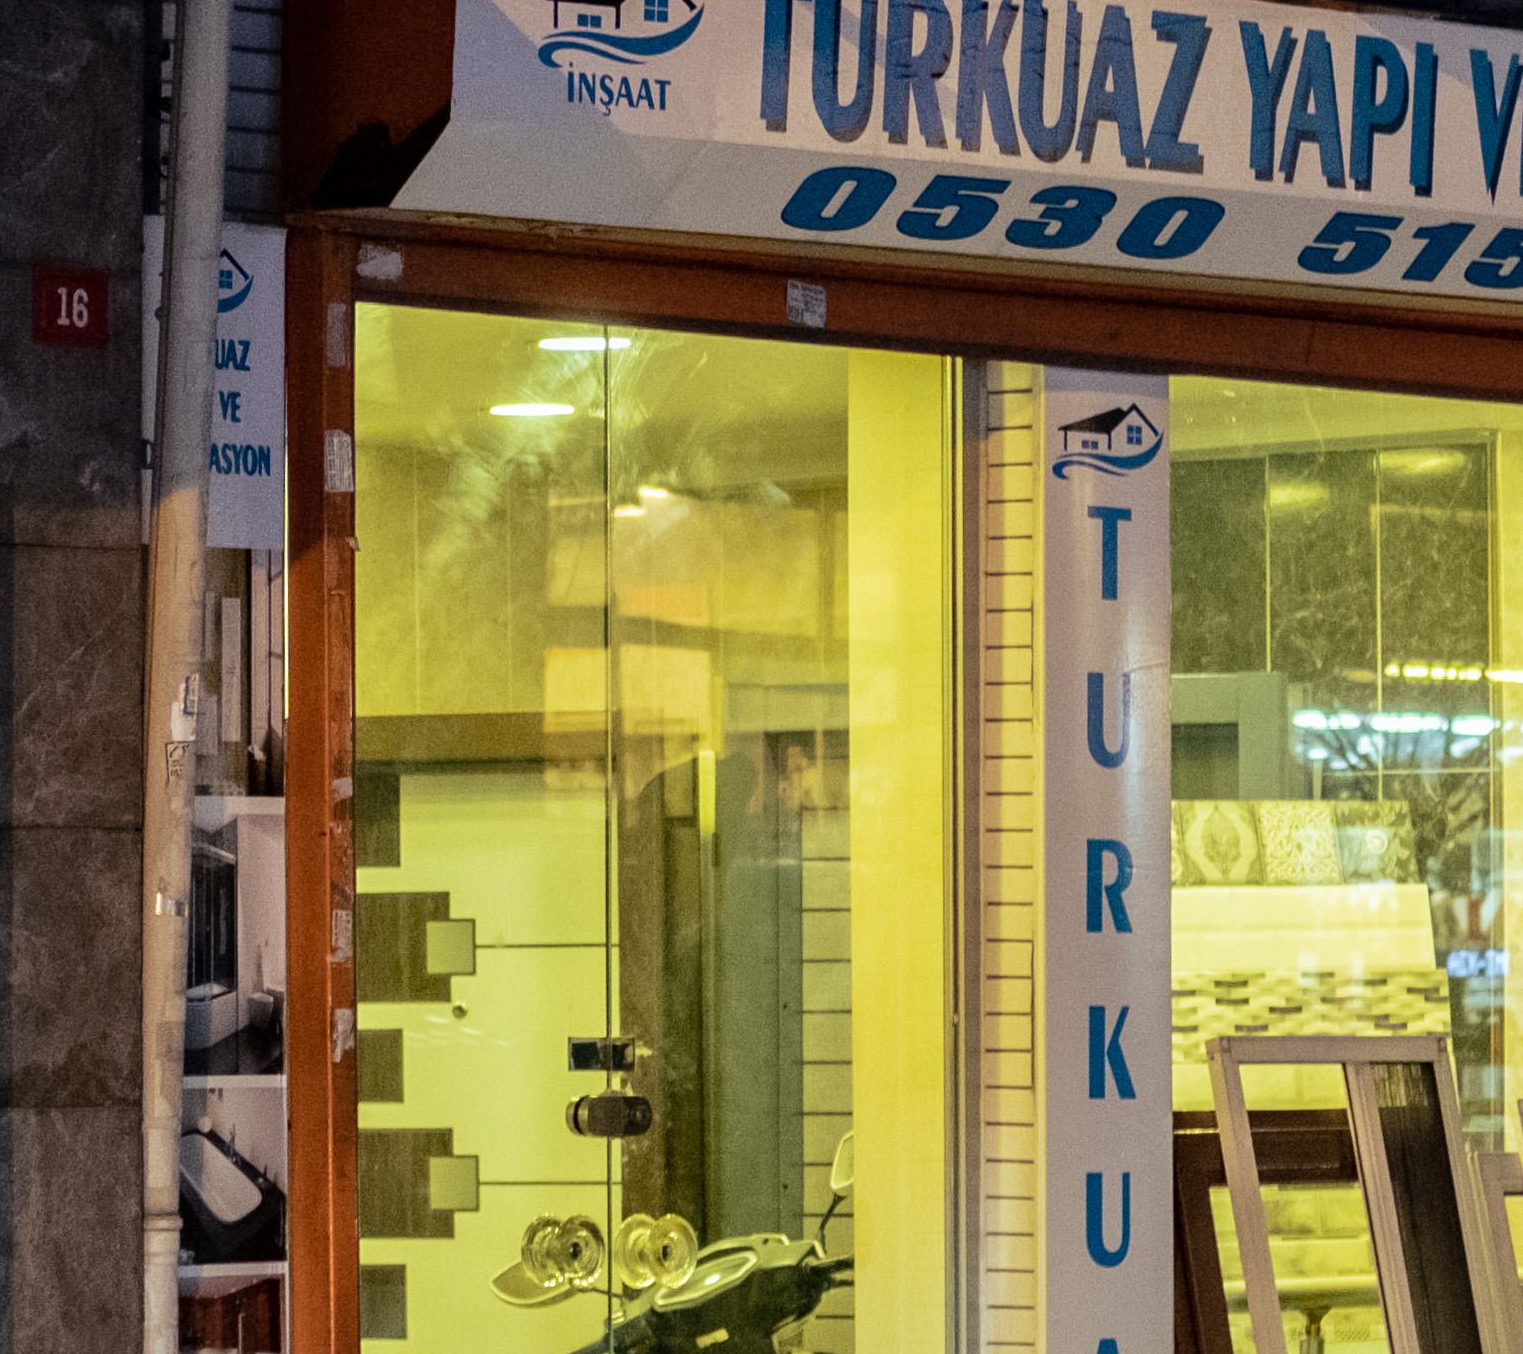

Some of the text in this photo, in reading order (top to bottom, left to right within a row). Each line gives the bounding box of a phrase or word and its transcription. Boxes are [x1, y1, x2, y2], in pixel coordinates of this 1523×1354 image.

[565, 69, 670, 117] İNŞAAT
[1239, 20, 1436, 198] YAPI
[780, 165, 1225, 260] 0530
[56, 286, 89, 328] 16
[219, 390, 242, 424] VE
